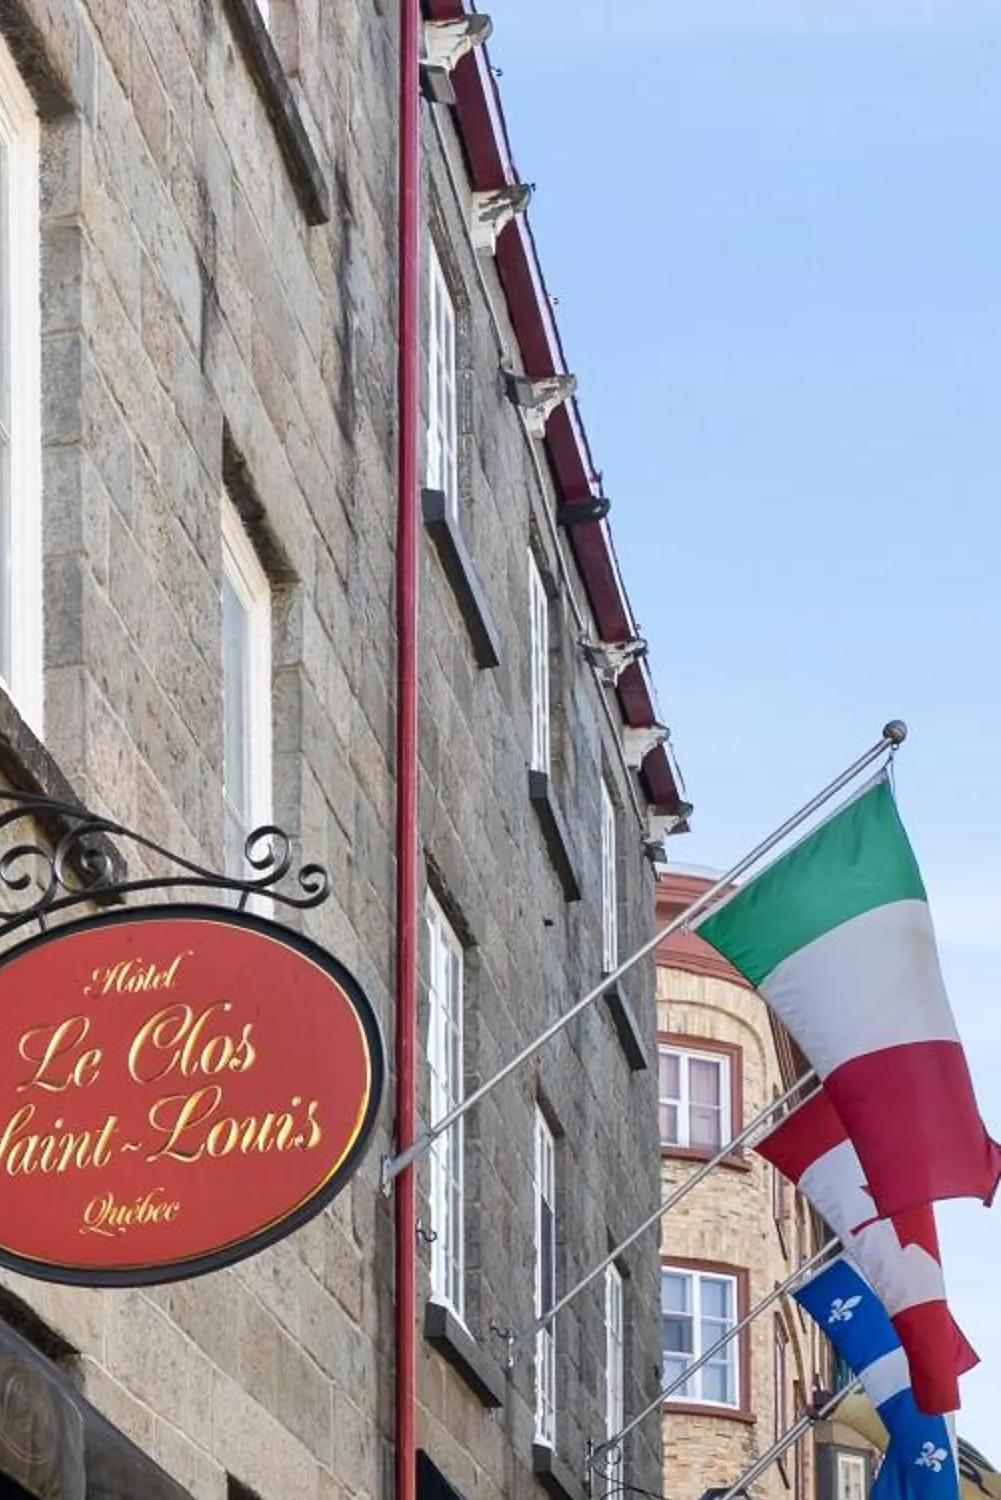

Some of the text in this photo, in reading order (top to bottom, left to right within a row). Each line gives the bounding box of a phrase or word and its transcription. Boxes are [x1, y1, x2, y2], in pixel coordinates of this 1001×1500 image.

[84, 951, 194, 996] Hôtel
[17, 1001, 256, 1093] Le Clos
[80, 1188, 181, 1237] Québec
